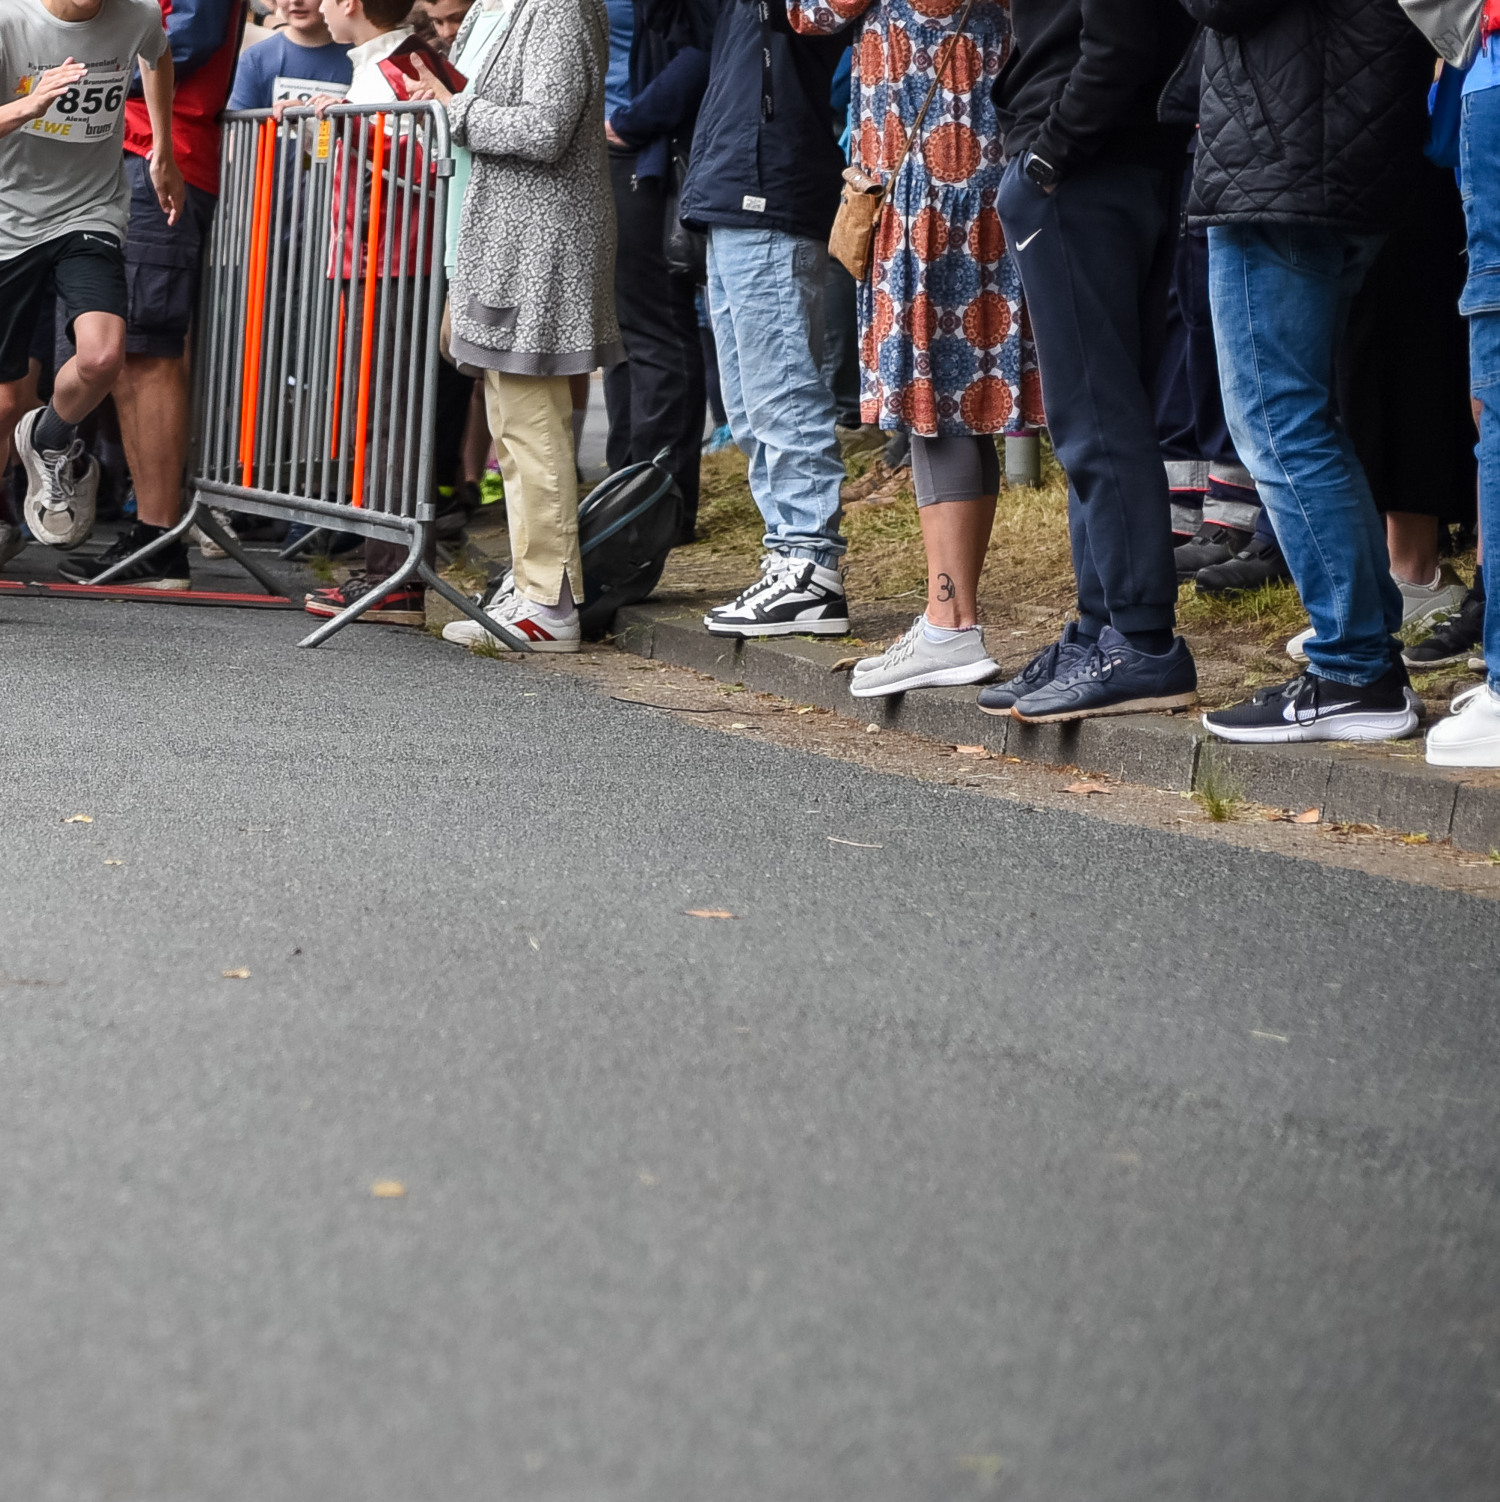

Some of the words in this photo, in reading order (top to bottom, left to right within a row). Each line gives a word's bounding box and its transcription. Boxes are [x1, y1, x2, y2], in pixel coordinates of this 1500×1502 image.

[83, 77, 124, 85] Brunnenlauf
[32, 119, 72, 136] EWE
[85, 123, 112, 136] bruns
